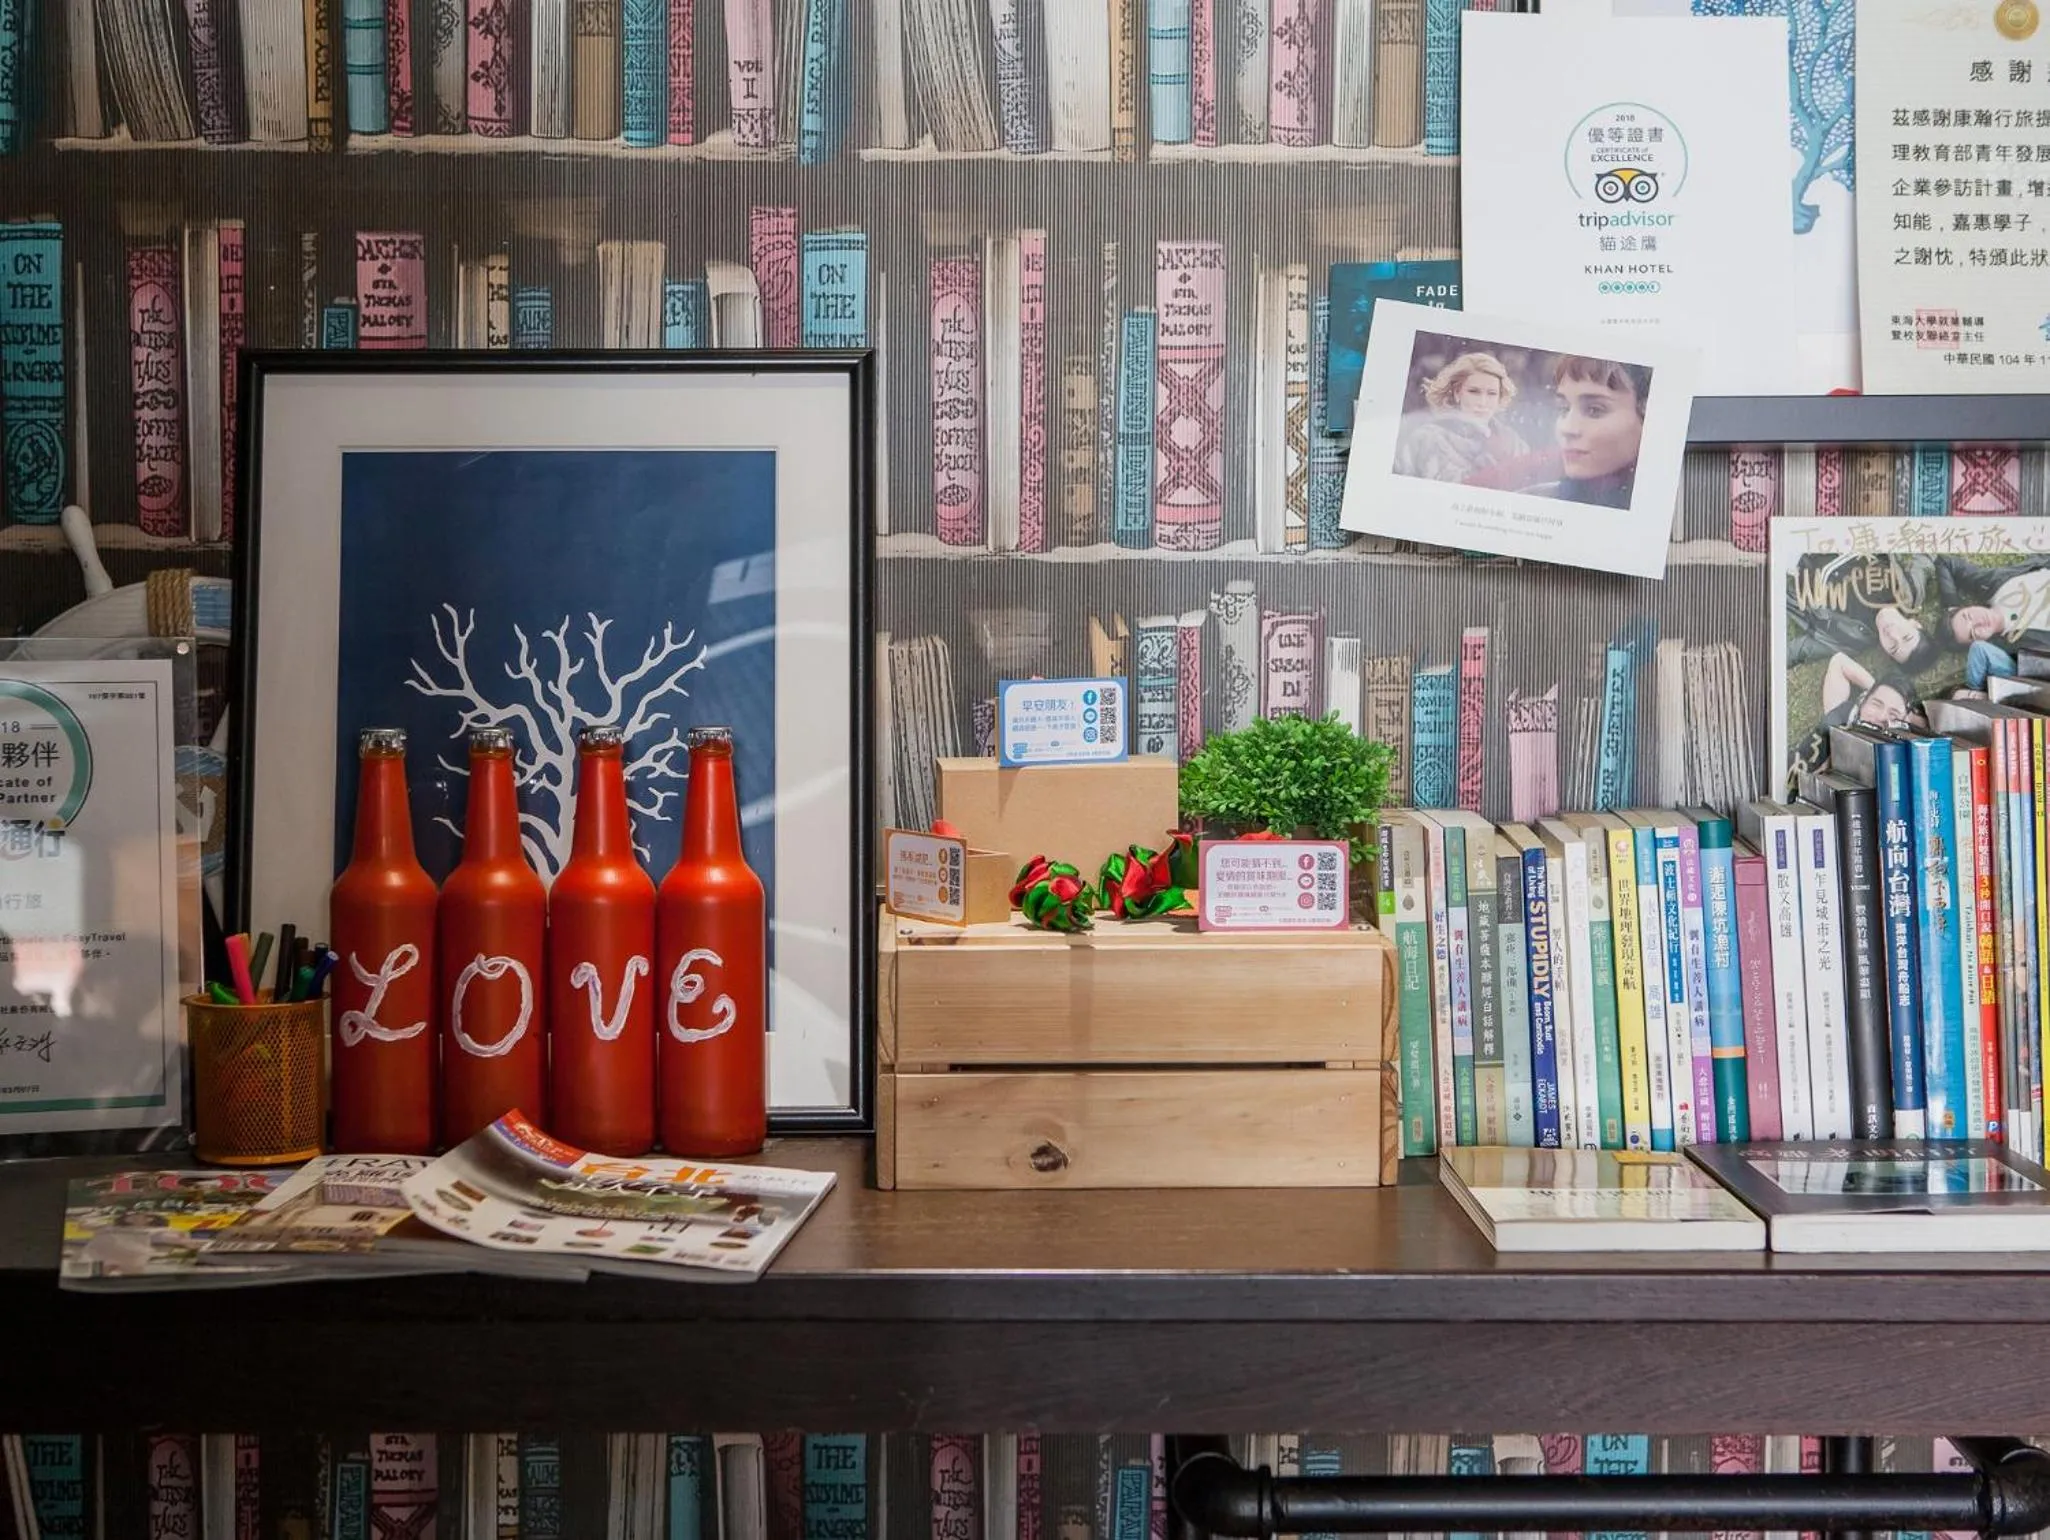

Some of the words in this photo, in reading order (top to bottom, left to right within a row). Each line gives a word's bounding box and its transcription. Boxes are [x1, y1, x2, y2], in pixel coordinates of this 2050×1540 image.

[1969, 59, 2050, 84] 感謝
[1588, 127, 1664, 143] 優等證書
[1590, 154, 1655, 162] EXCELLENCE
[1892, 178, 2050, 198] 企業參訪計畫，增
[1578, 211, 1675, 230] tripadvisor
[1600, 235, 1657, 251] 貓途鷹
[818, 263, 848, 285] ON
[1584, 264, 1624, 274] KHAN
[1628, 264, 1674, 274] HOTEL
[7, 284, 52, 310] THE
[1416, 285, 1459, 297] FADE
[810, 293, 856, 320] THE
[1944, 352, 1995, 366] 中華民國
[2000, 355, 2020, 365] 104
[2024, 354, 2036, 366] 年
[1, 741, 61, 769] 夥伴
[36, 776, 52, 788] of
[1886, 819, 1911, 917] 航向台灣
[1814, 873, 1832, 971] 乍見城市之光
[1529, 900, 1551, 999] STUPIDLY
[812, 1443, 857, 1471] THE
